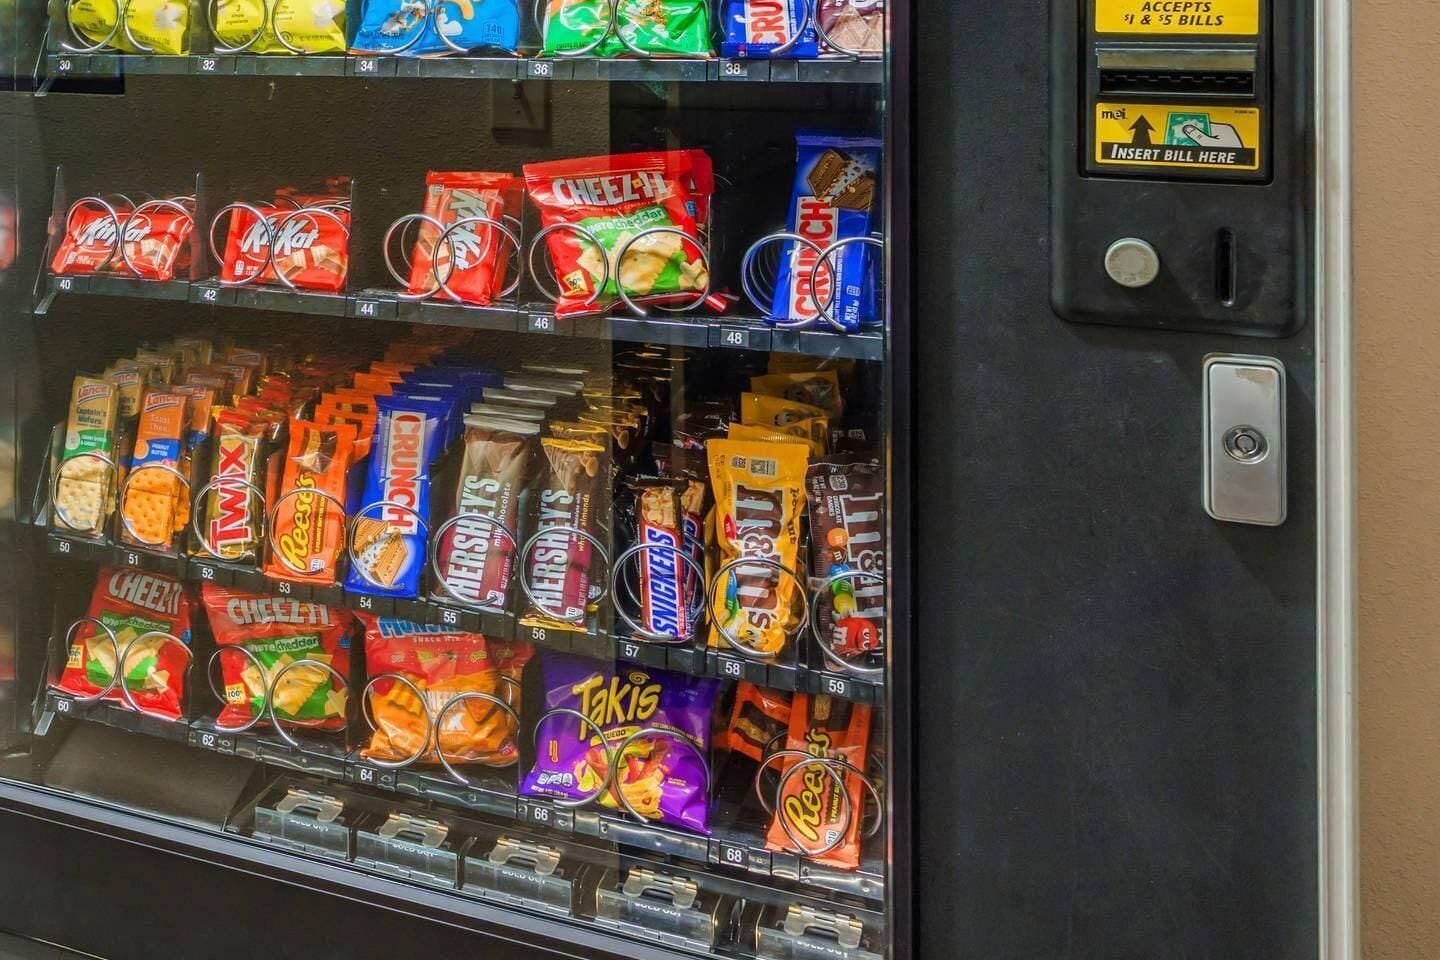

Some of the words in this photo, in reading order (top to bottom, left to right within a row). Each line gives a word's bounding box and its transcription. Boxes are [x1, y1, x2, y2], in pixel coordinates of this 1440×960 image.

[1141, 1, 1212, 12] ACCEPTS
[1124, 13, 1135, 25] $1
[1140, 15, 1151, 25] &
[1159, 14, 1173, 25] $5
[1178, 15, 1224, 26] BILLS
[59, 60, 70, 71] 30
[203, 60, 215, 70] 32
[360, 60, 373, 71] 34
[534, 64, 548, 74] 36
[726, 63, 741, 74] 38
[1111, 143, 1160, 161] INSERT
[1163, 149, 1194, 162] BILL
[1198, 151, 1236, 164] HERE
[241, 216, 320, 250] KiKat
[60, 279, 71, 289] 40
[204, 290, 216, 300] 42
[361, 304, 374, 315] 44
[535, 317, 548, 329] 46
[727, 332, 742, 344] 48
[78, 384, 110, 401] Lance
[386, 414, 425, 534] CRUNCH
[280, 473, 316, 570] Reese's
[446, 474, 500, 604] HERSHEY'S
[59, 542, 70, 552] 50
[533, 489, 575, 607] HERSHEY'S
[128, 554, 139, 564] 51
[202, 568, 214, 579] 52
[279, 583, 290, 593] 53
[647, 528, 679, 638] SNICKERS
[360, 597, 372, 609] 54
[443, 611, 457, 623] 55
[532, 628, 546, 640] 56
[276, 636, 318, 651] cheddar
[625, 645, 640, 656] 57
[725, 662, 740, 675] 58
[829, 680, 845, 693] 59
[58, 700, 69, 711] 60
[572, 674, 663, 742] Takis
[202, 735, 214, 746] 62
[361, 769, 373, 780] 64
[784, 728, 830, 841] Reese's
[535, 808, 549, 821] 66
[726, 849, 742, 862] 68
